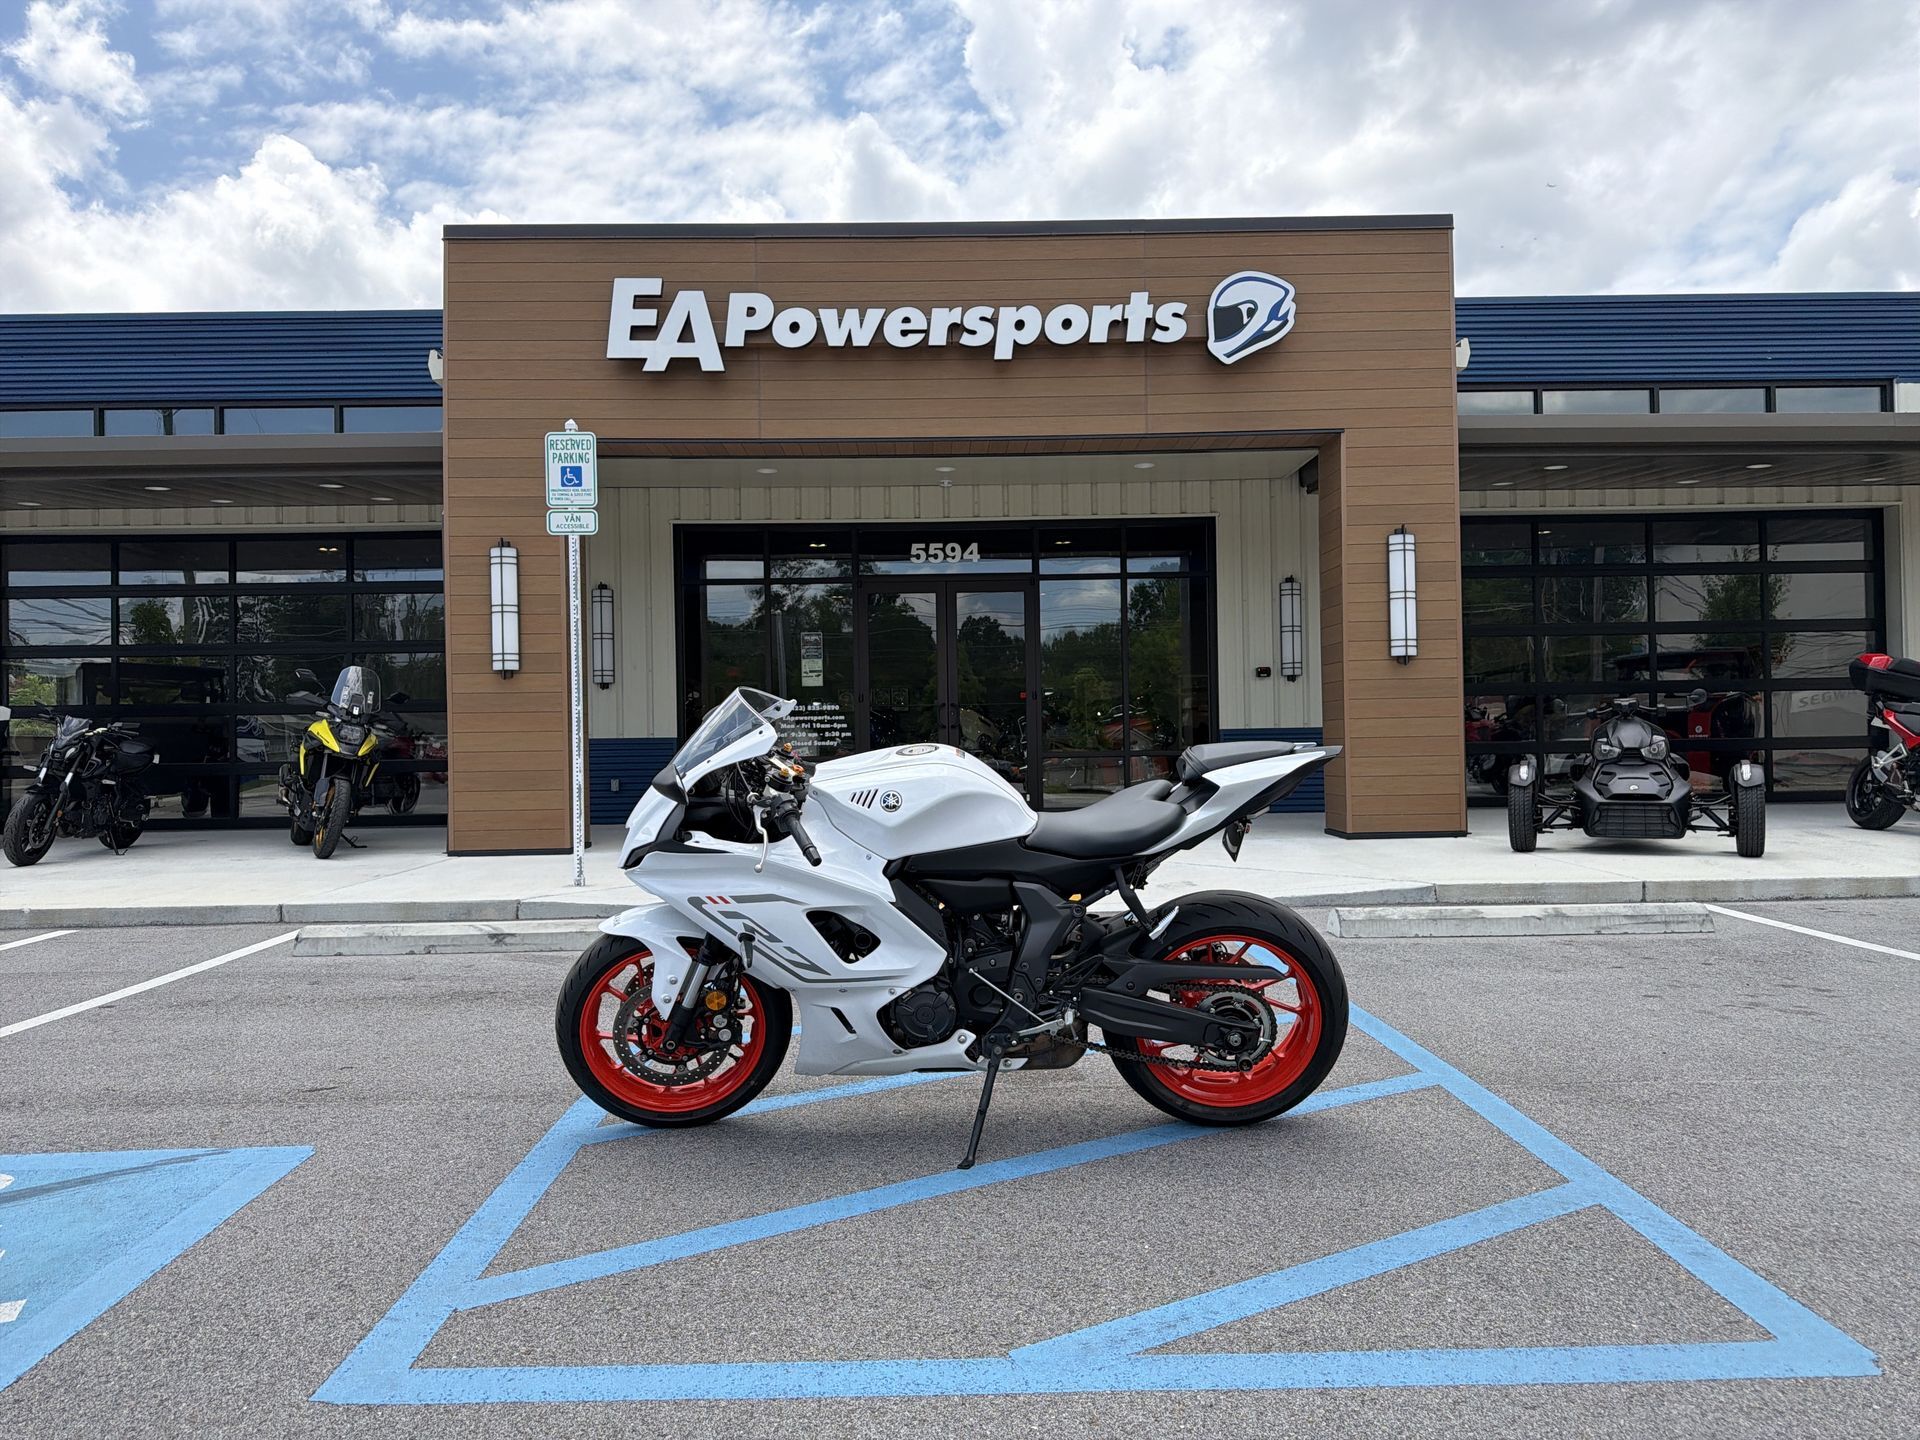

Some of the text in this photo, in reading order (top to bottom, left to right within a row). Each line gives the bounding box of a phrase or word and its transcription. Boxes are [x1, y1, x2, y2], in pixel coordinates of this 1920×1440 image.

[606, 277, 1188, 372] EA Powersports
[550, 439, 592, 451] RESERVED
[552, 452, 590, 464] PARKING
[910, 542, 980, 563] 5594
[794, 704, 805, 712] 23)
